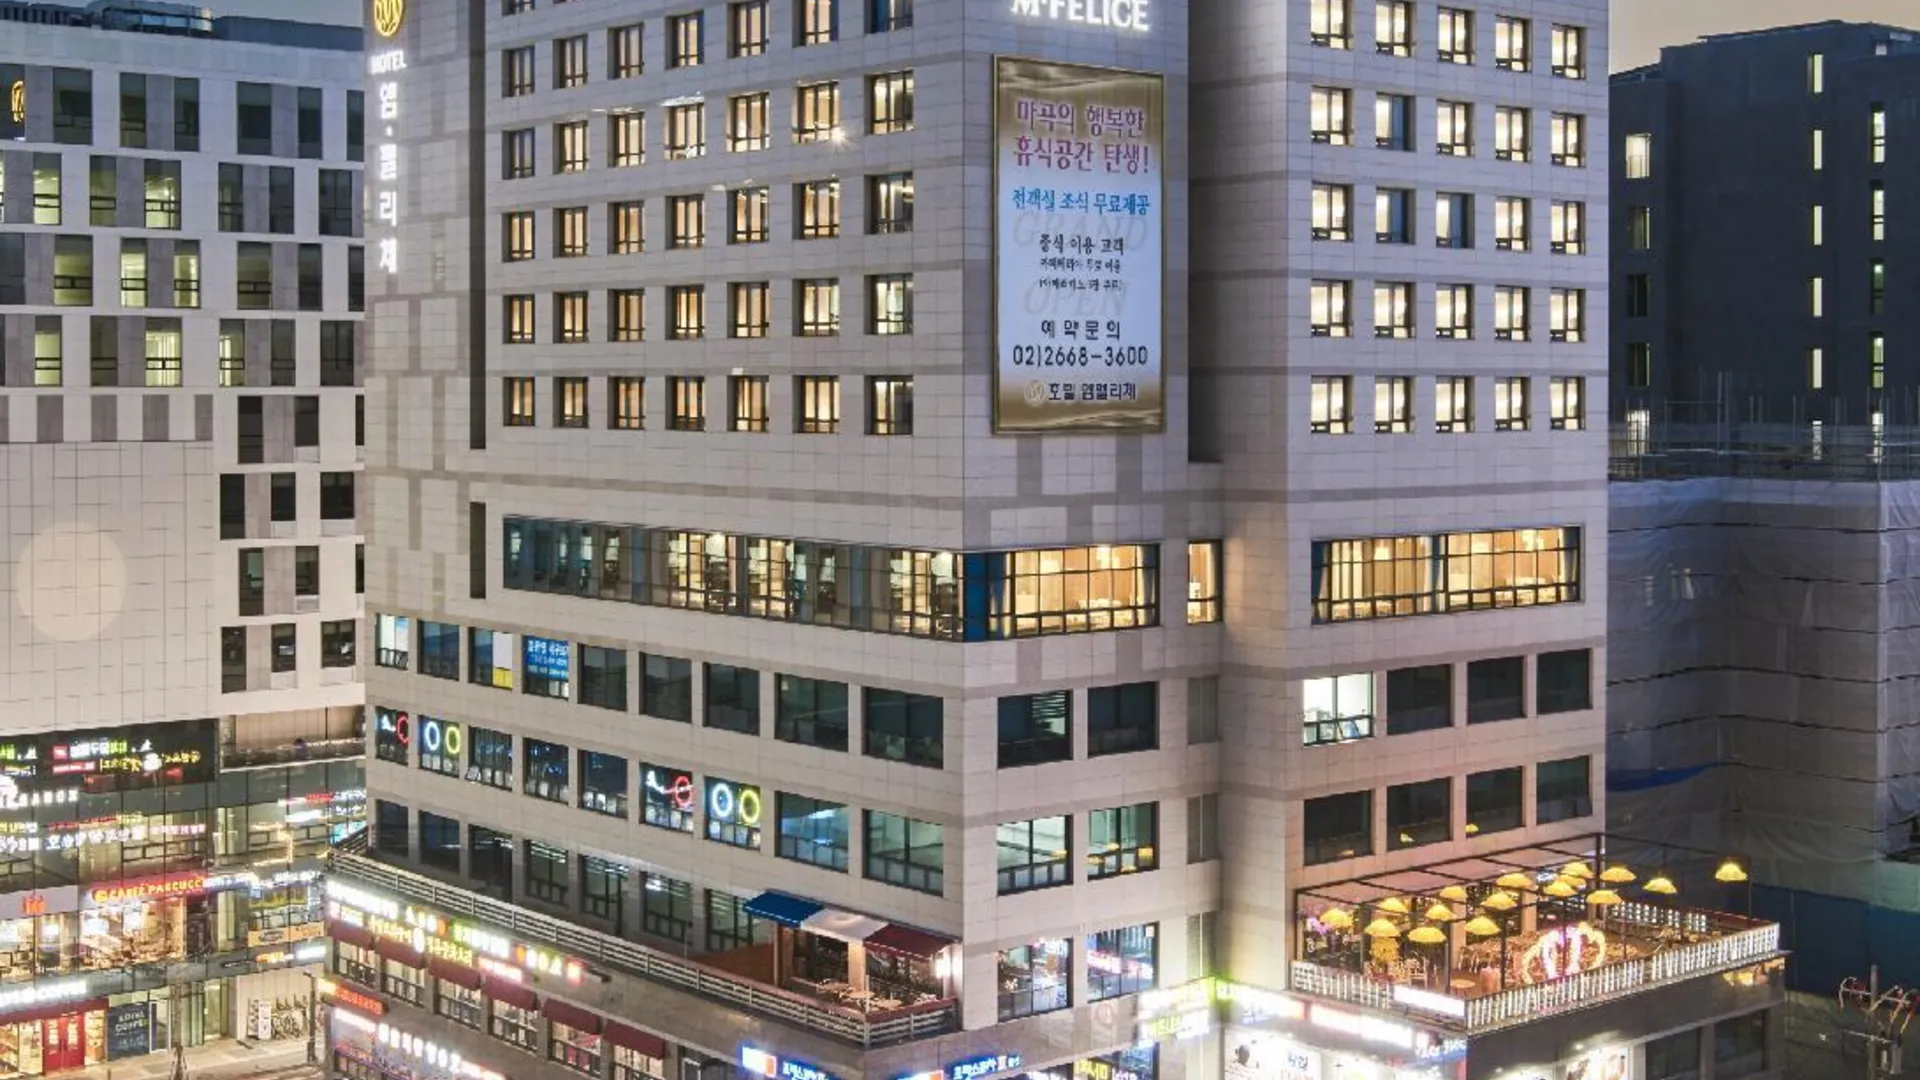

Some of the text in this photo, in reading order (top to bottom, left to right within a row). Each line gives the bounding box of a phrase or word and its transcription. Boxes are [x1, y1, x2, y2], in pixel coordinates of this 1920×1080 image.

[369, 50, 407, 75] HOTEL
[1017, 101, 1145, 138] 마곡의 행복한
[1013, 135, 1149, 175] 휴식공간 탄생!
[1013, 186, 1150, 216] 전객실 조식 무료제공
[1070, 235, 1095, 255] 이용
[1013, 344, 1149, 367] 02)2668-3600
